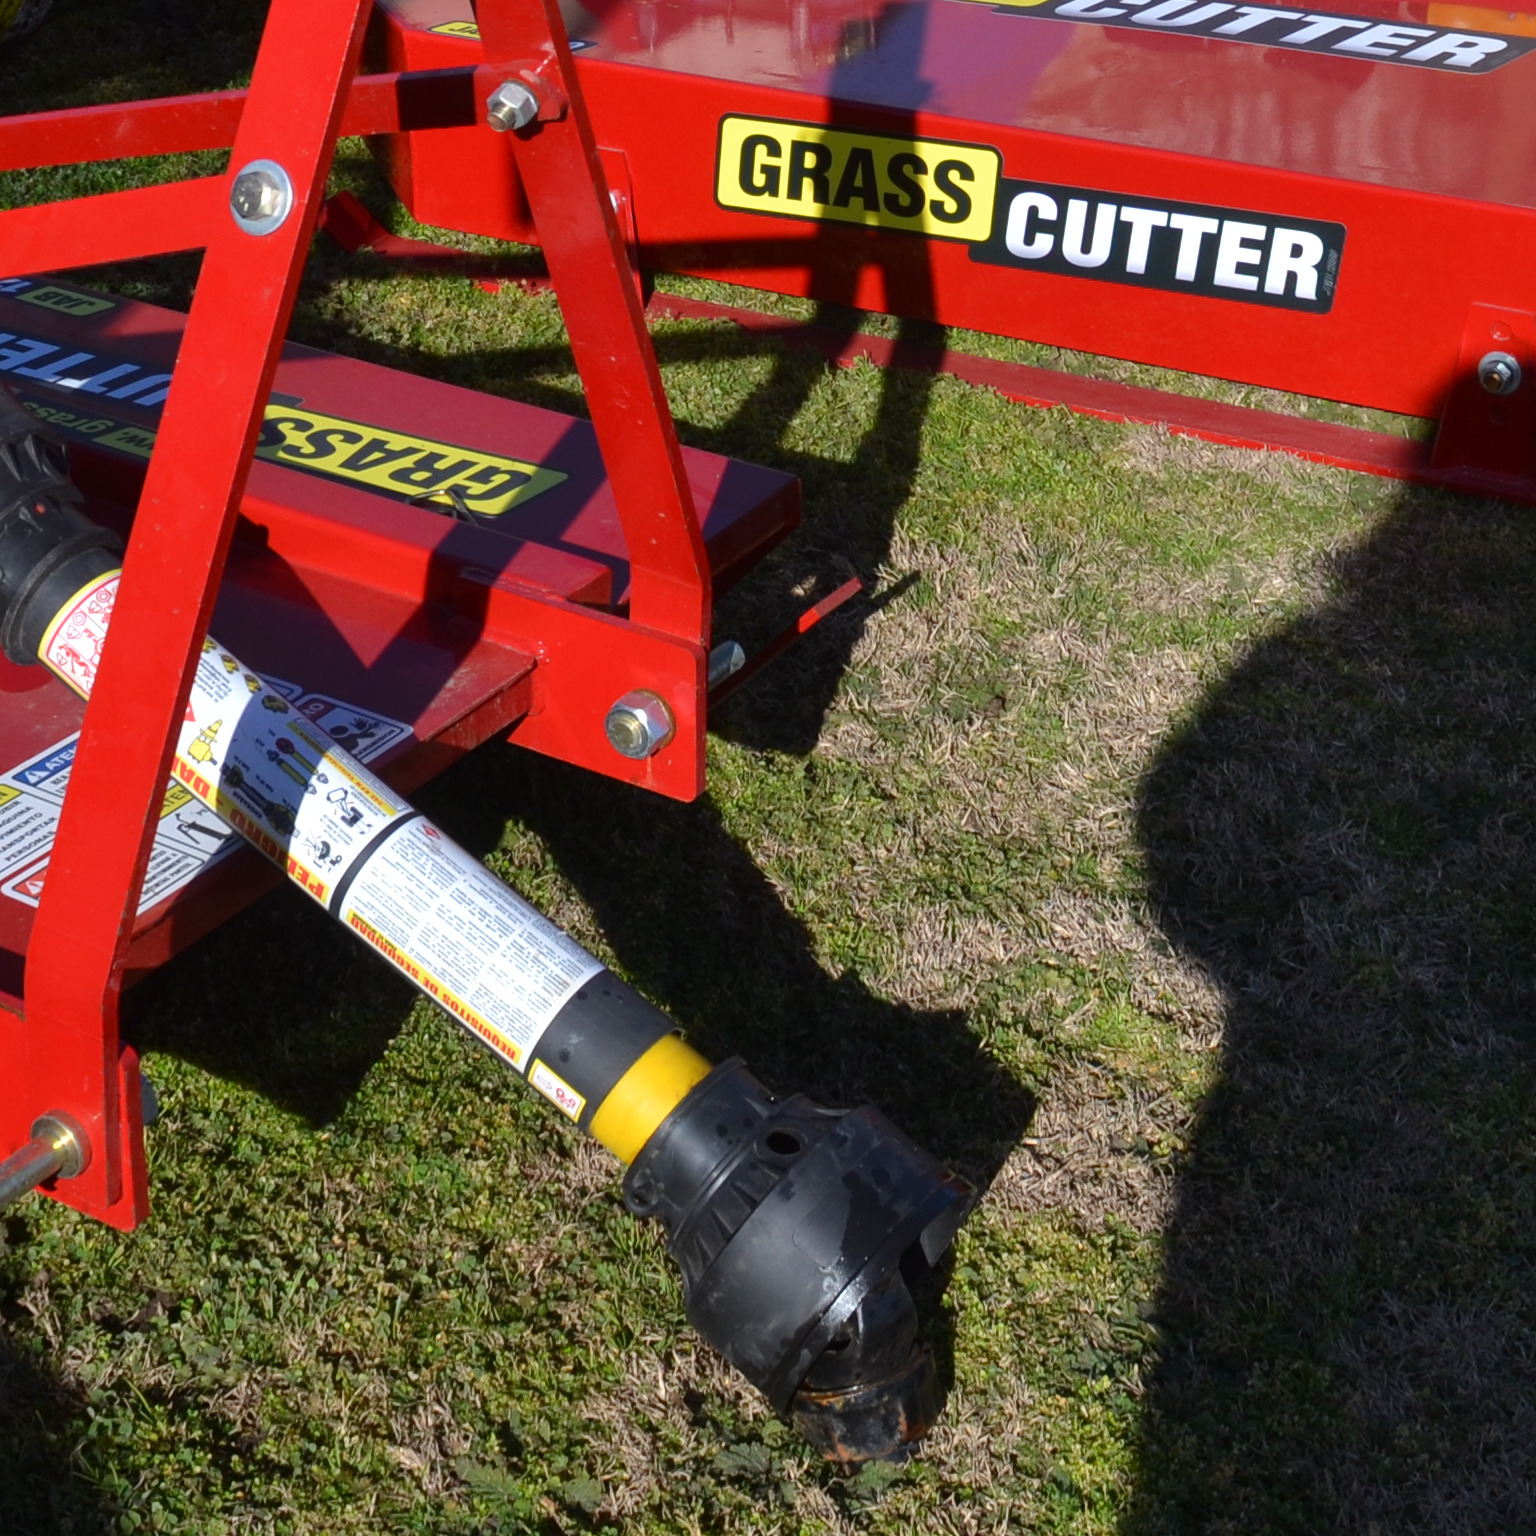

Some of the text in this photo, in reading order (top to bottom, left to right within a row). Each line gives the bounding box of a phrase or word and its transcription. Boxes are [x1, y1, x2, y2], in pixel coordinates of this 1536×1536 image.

[738, 132, 1324, 302] GRASS CUTTER
[33, 290, 97, 310] JAB
[257, 416, 534, 502] GRASS
[45, 746, 76, 771] ATEN
[166, 754, 213, 797] DA
[223, 805, 329, 898] PELIGRO
[348, 915, 420, 979] SEGURIDAD
[419, 974, 441, 996] DE
[440, 992, 517, 1059] REQUISITOS
